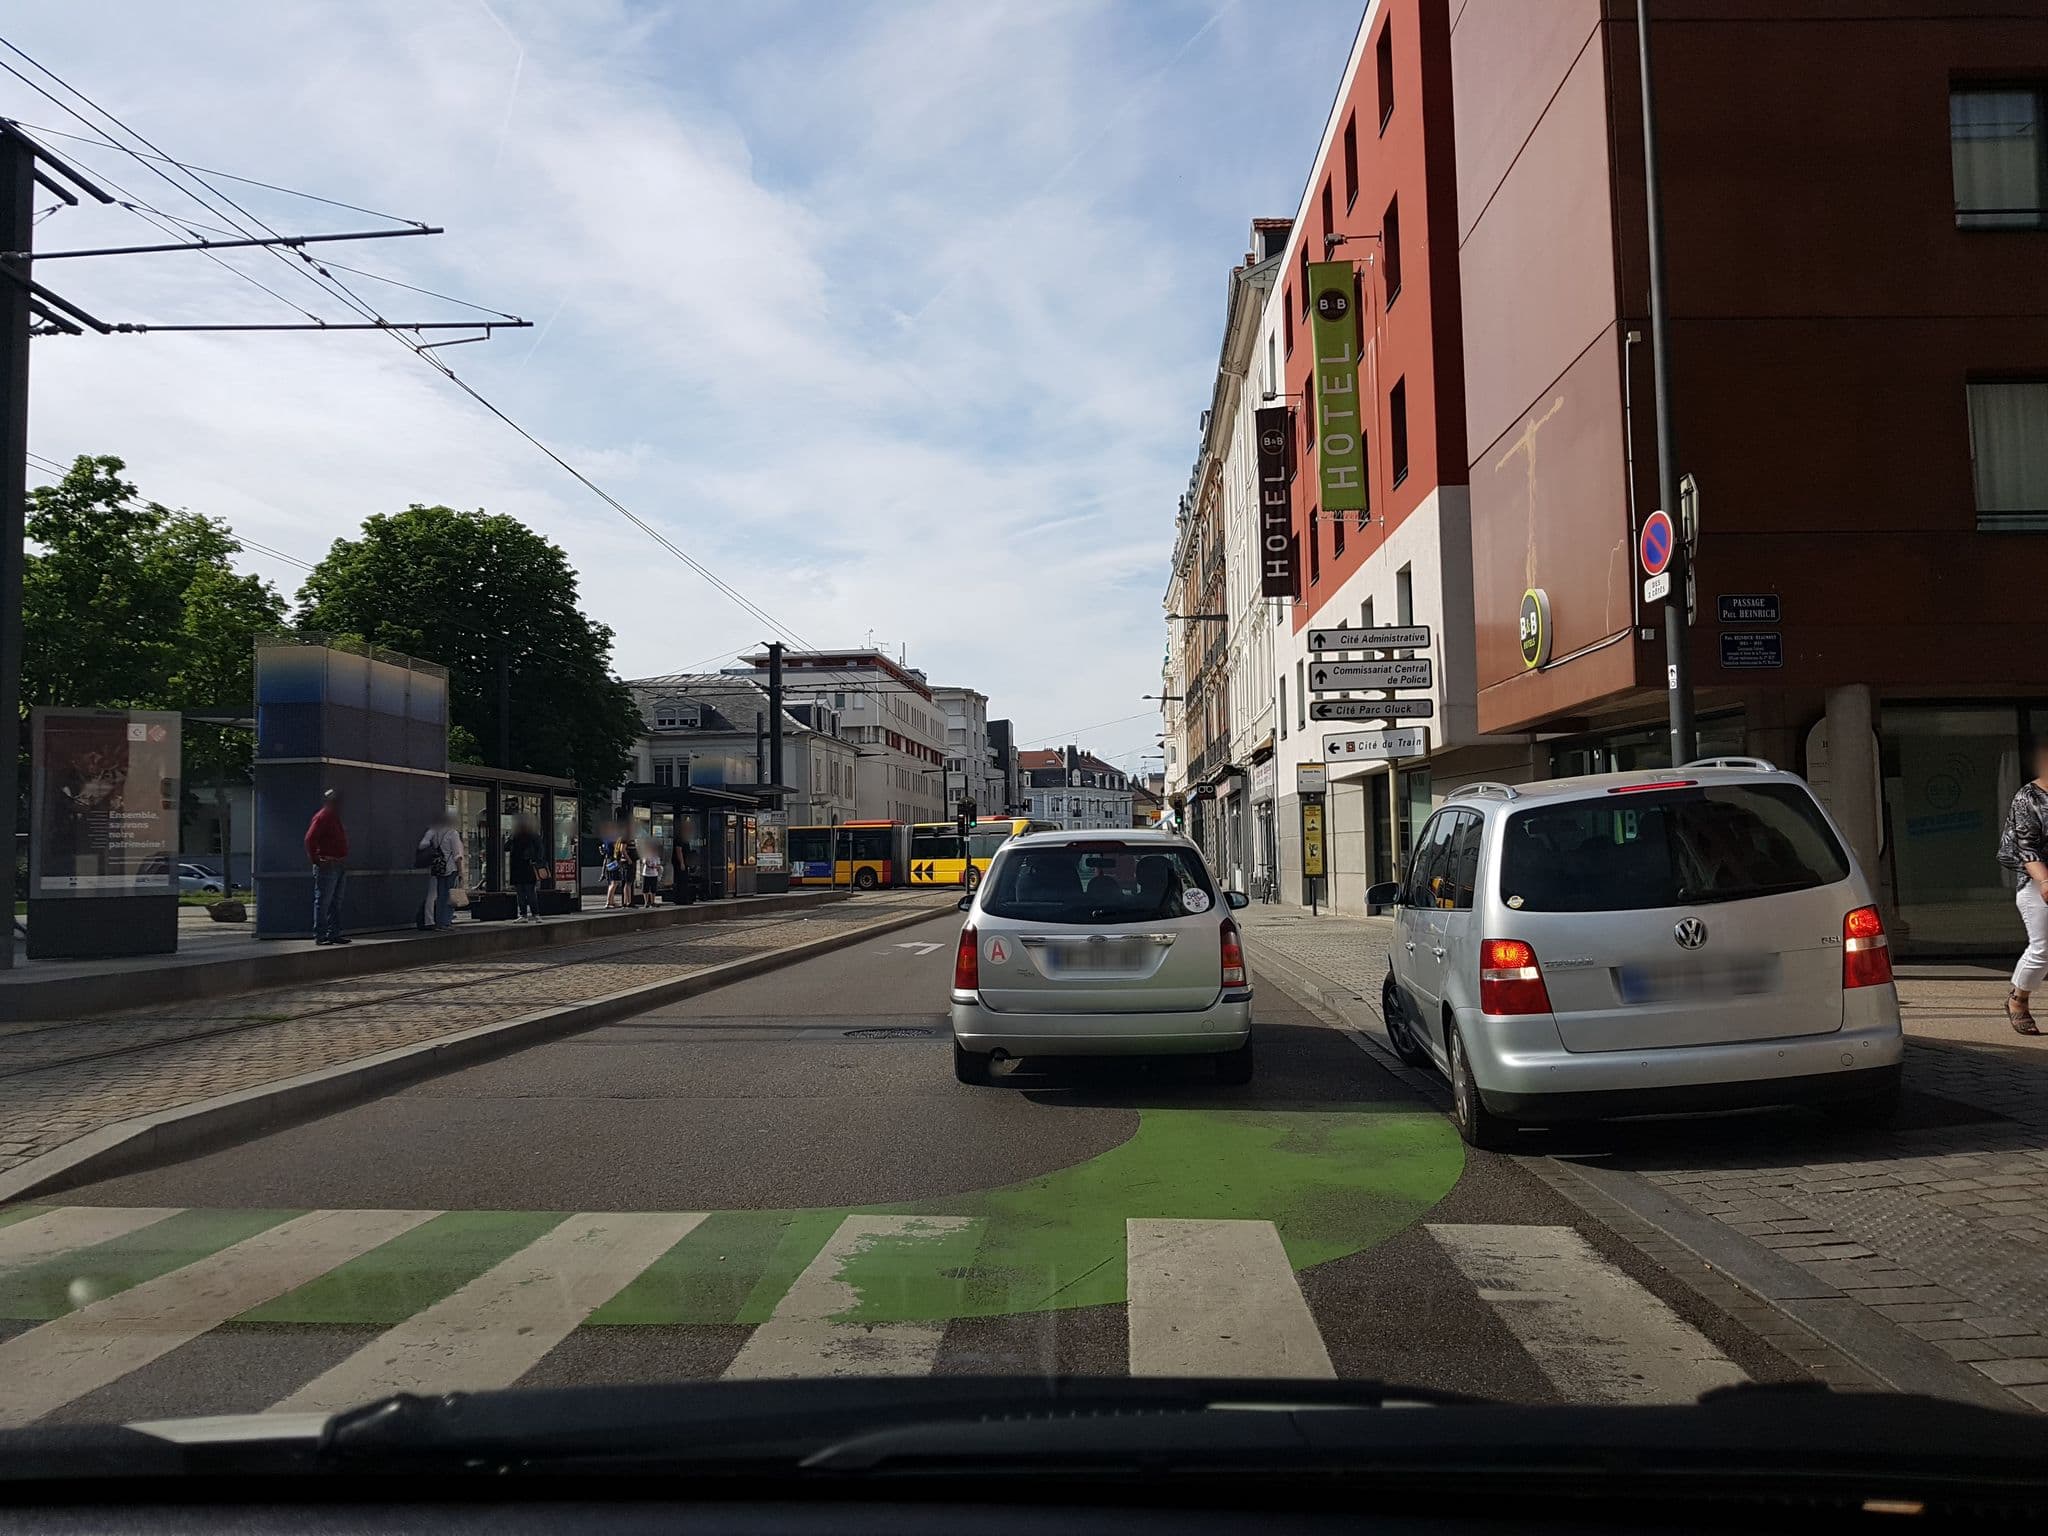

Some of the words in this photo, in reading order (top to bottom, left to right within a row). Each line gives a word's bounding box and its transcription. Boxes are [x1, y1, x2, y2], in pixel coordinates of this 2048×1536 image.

[1320, 343, 1359, 489] HOTEL
[1264, 466, 1289, 578] HOTEL
[1732, 598, 1765, 607] PASSAGE
[1739, 609, 1776, 618] HEINRICH
[1520, 612, 1537, 641] B&B
[1340, 634, 1359, 645] Cité
[1361, 632, 1425, 644] Administrative
[1333, 665, 1392, 675] Commissariat
[1395, 664, 1427, 674] Central
[1387, 676, 1399, 685] de
[1400, 675, 1427, 684] Police
[1336, 704, 1356, 716] Cité
[1359, 704, 1381, 715] Parc
[1384, 703, 1412, 714] Gluck
[1358, 739, 1378, 751] Cité
[1382, 739, 1393, 749] du
[1398, 737, 1422, 748] Train
[991, 939, 1006, 961] A
